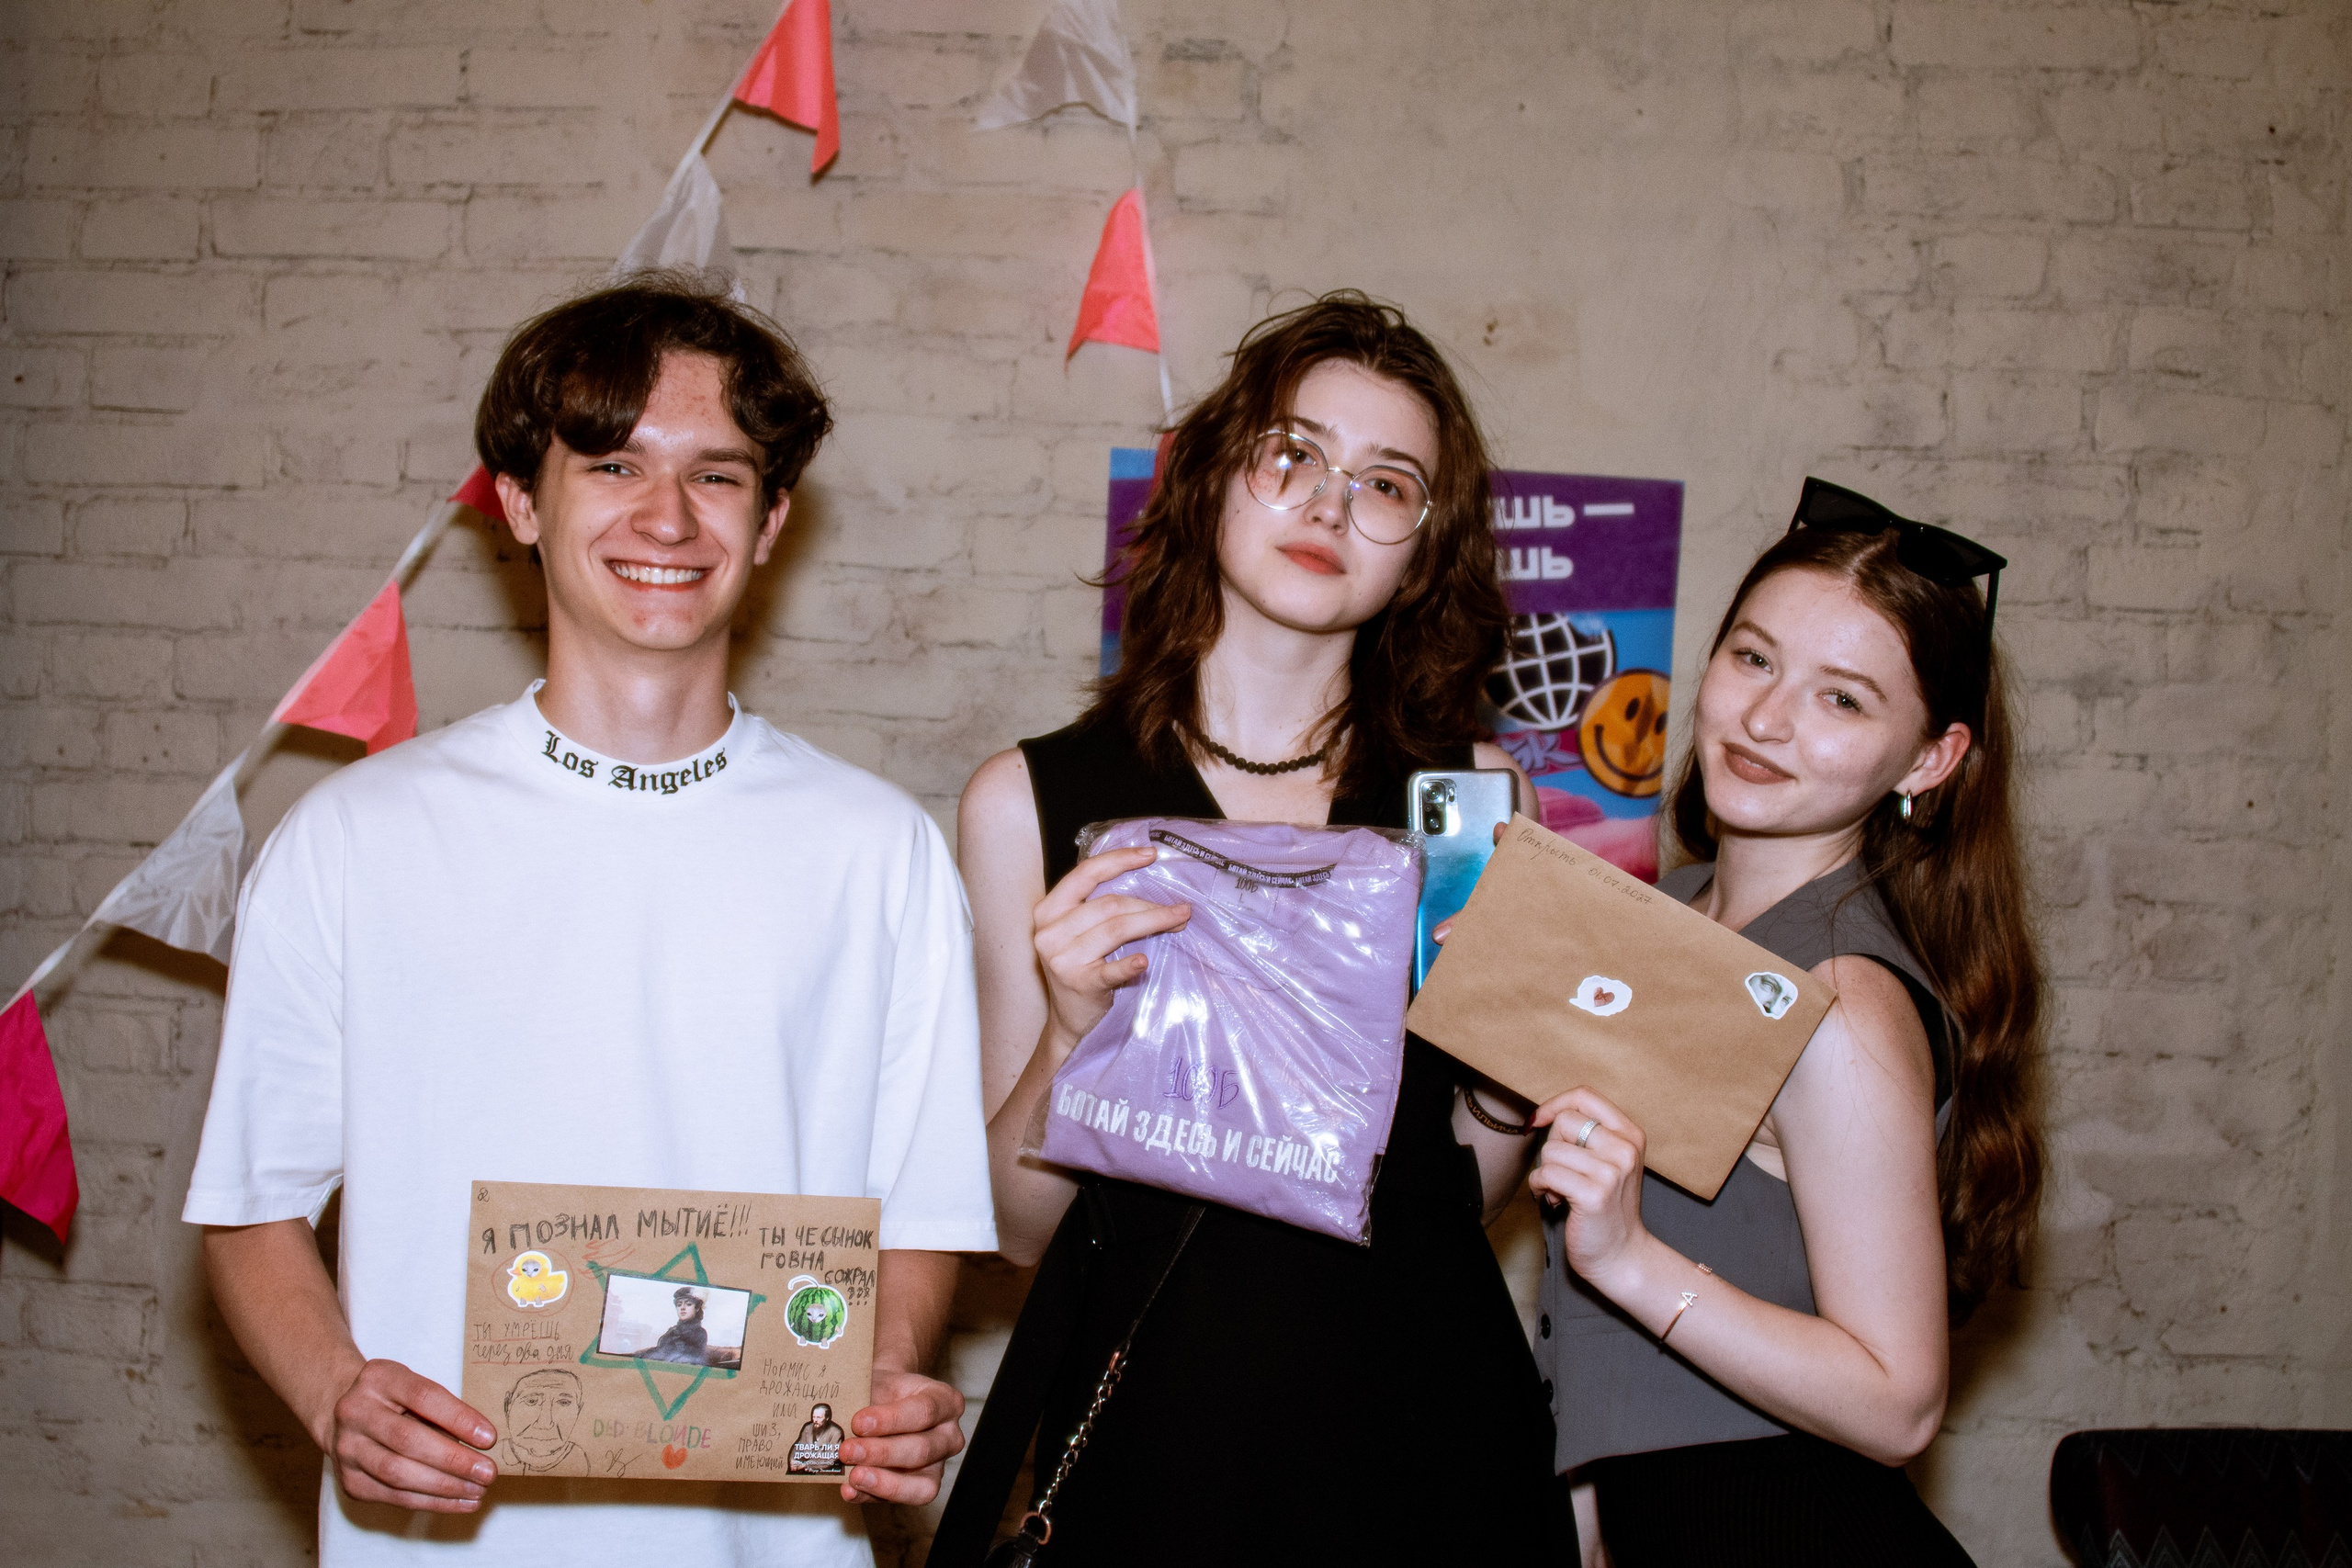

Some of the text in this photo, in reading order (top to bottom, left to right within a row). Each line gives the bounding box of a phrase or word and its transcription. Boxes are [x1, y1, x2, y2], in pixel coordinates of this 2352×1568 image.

[541, 730, 728, 795] Los Angeles
[1517, 828, 1577, 865] Открыть
[1057, 1083, 1341, 1184] БОТАЙ ЗДЕСЬ И СЕЙЧАС
[481, 1227, 496, 1255] Я
[509, 1212, 619, 1250] ПОЗНАЛ
[759, 1225, 786, 1247] ТЫ
[760, 1250, 825, 1271] ГОВНА
[824, 1267, 876, 1288] СОЖРАЛ
[473, 1319, 560, 1341] ТЫ УМРЁШЬ
[472, 1341, 574, 1366] через два дня
[759, 1380, 840, 1401] ДРОЖАЩИЙ
[773, 1402, 797, 1418] ИЛИ
[738, 1438, 774, 1452] ПРАВО
[794, 1451, 839, 1460] ДРОЖАЩАЯ
[795, 1443, 840, 1451] ТВАРЬ ЛИ Я
